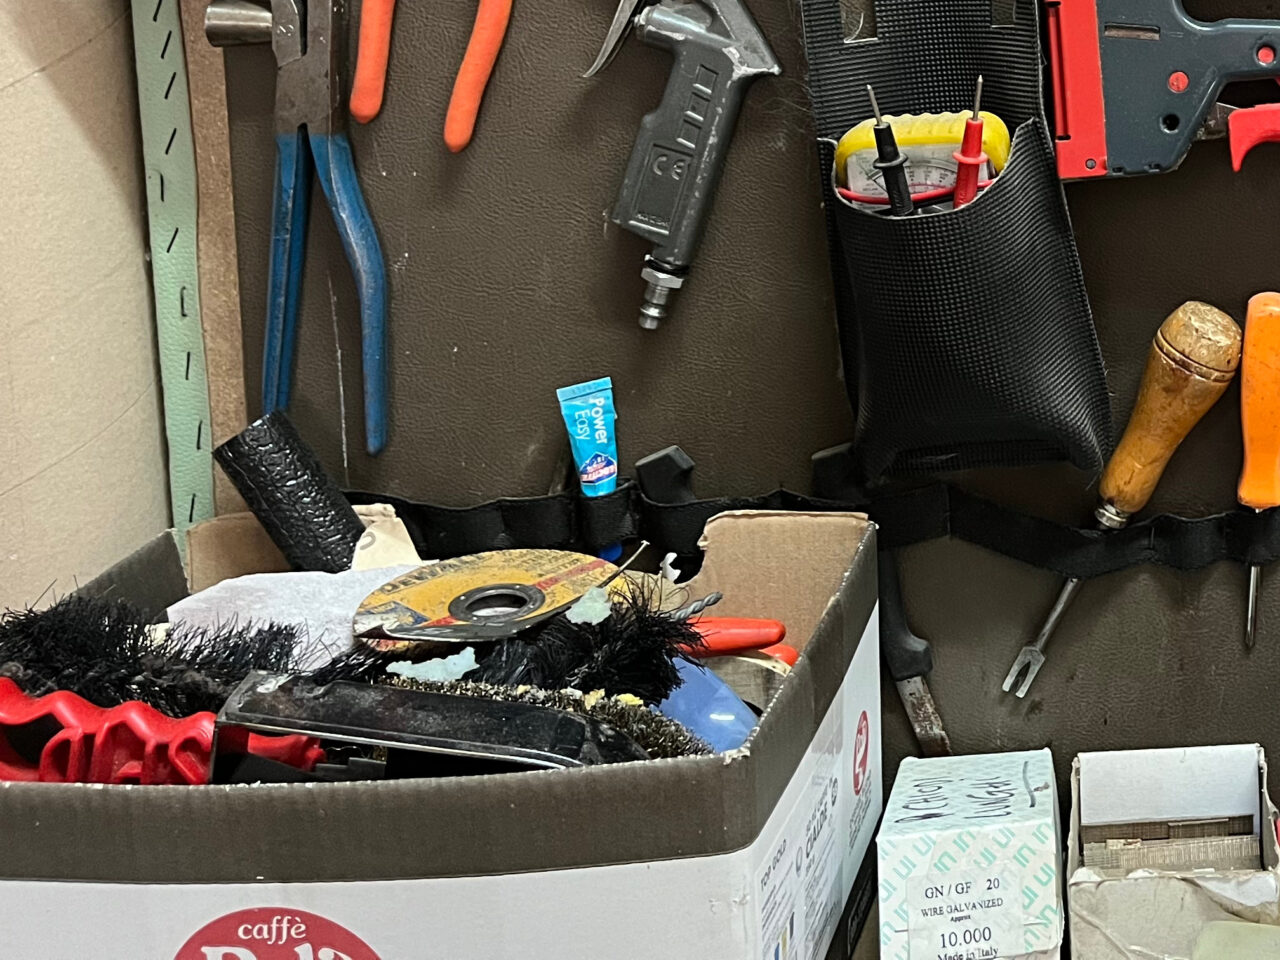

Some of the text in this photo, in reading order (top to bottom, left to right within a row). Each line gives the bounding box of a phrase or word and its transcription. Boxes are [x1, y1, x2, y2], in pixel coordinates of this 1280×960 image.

[573, 409, 591, 442] Easy
[590, 396, 609, 445] Power
[805, 799, 829, 859] CIALDE
[925, 885, 944, 898] GN
[955, 882, 972, 895] GF
[986, 878, 1000, 889] 20
[921, 898, 1004, 917] WIRE GALVANIZED
[237, 915, 306, 945] caffè
[941, 927, 992, 948] 10.000
[977, 945, 999, 959] Italy
